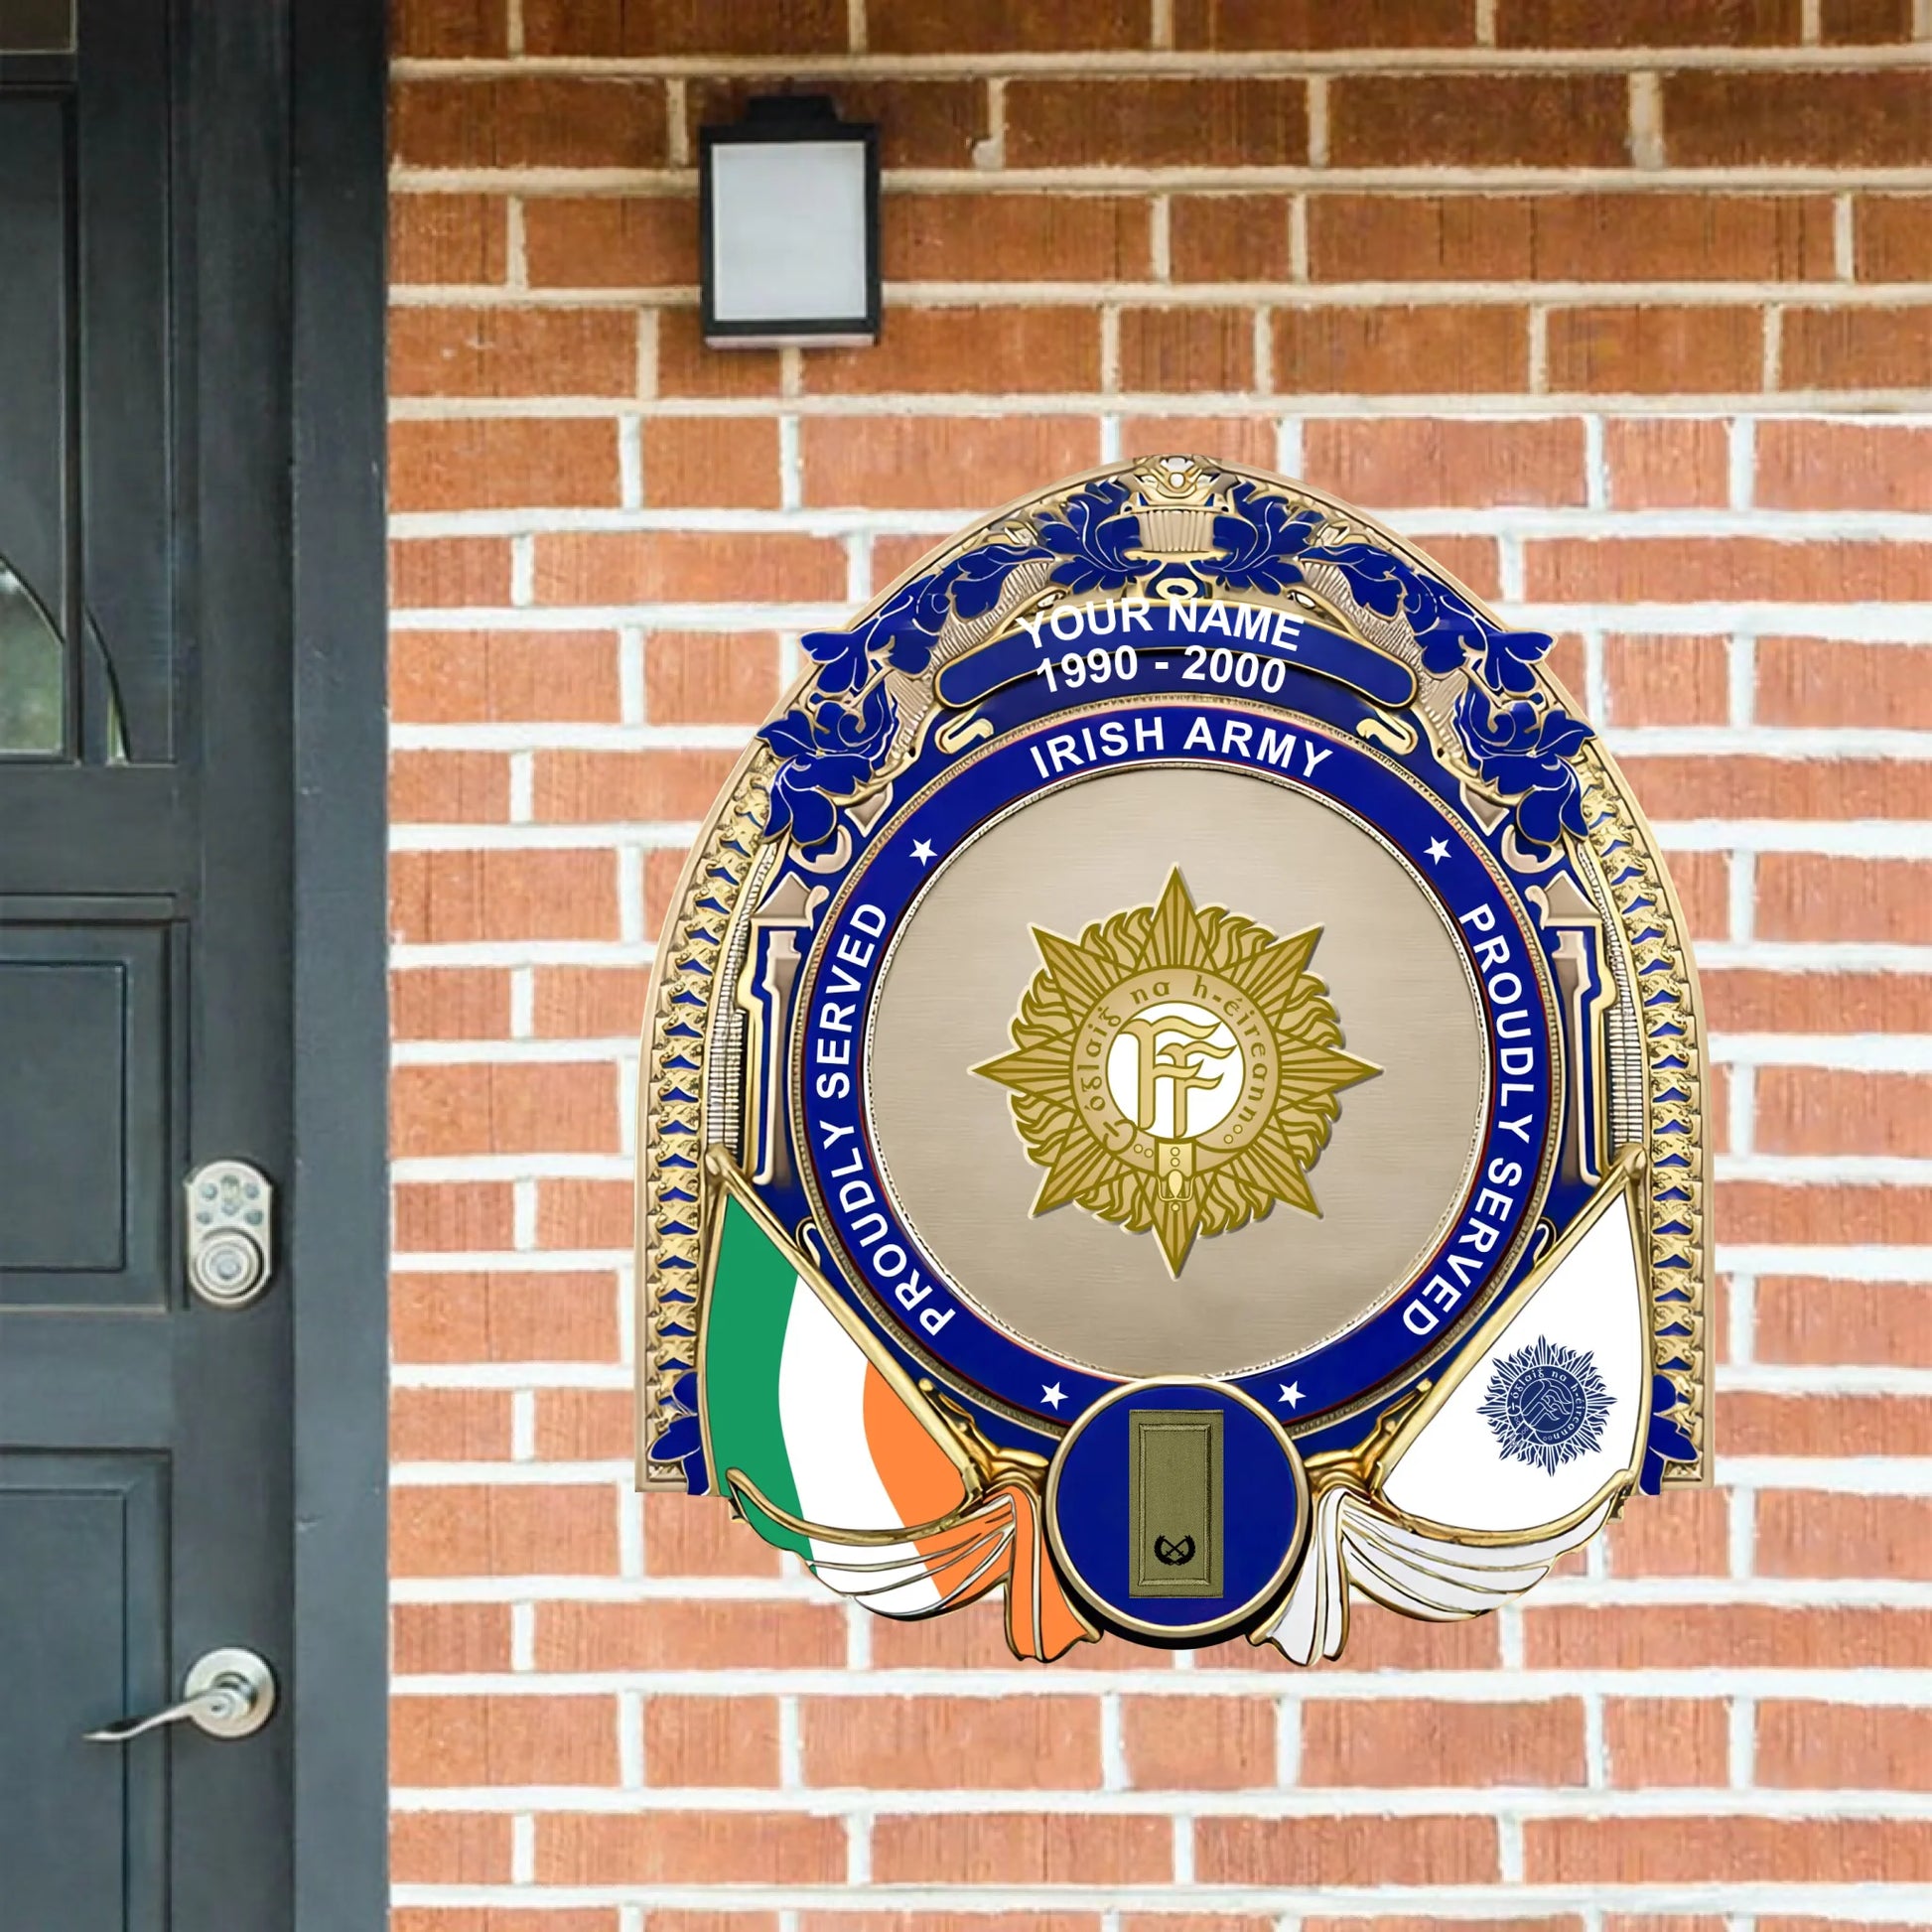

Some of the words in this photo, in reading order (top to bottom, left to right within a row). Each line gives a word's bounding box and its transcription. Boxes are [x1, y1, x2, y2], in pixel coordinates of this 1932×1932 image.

[1016, 597, 1155, 649] YOUR
[1168, 598, 1306, 651] NAME
[1036, 645, 1138, 693] 1990
[1181, 645, 1287, 694] 2000
[1030, 716, 1165, 779] IRISH
[1183, 716, 1333, 778] ARMY
[816, 902, 887, 1100] SERVED
[1130, 981, 1171, 1005] na
[1458, 902, 1534, 1145] PROUDLY
[820, 1120, 956, 1336] PROUDLY
[1402, 1158, 1523, 1335] SERVED
